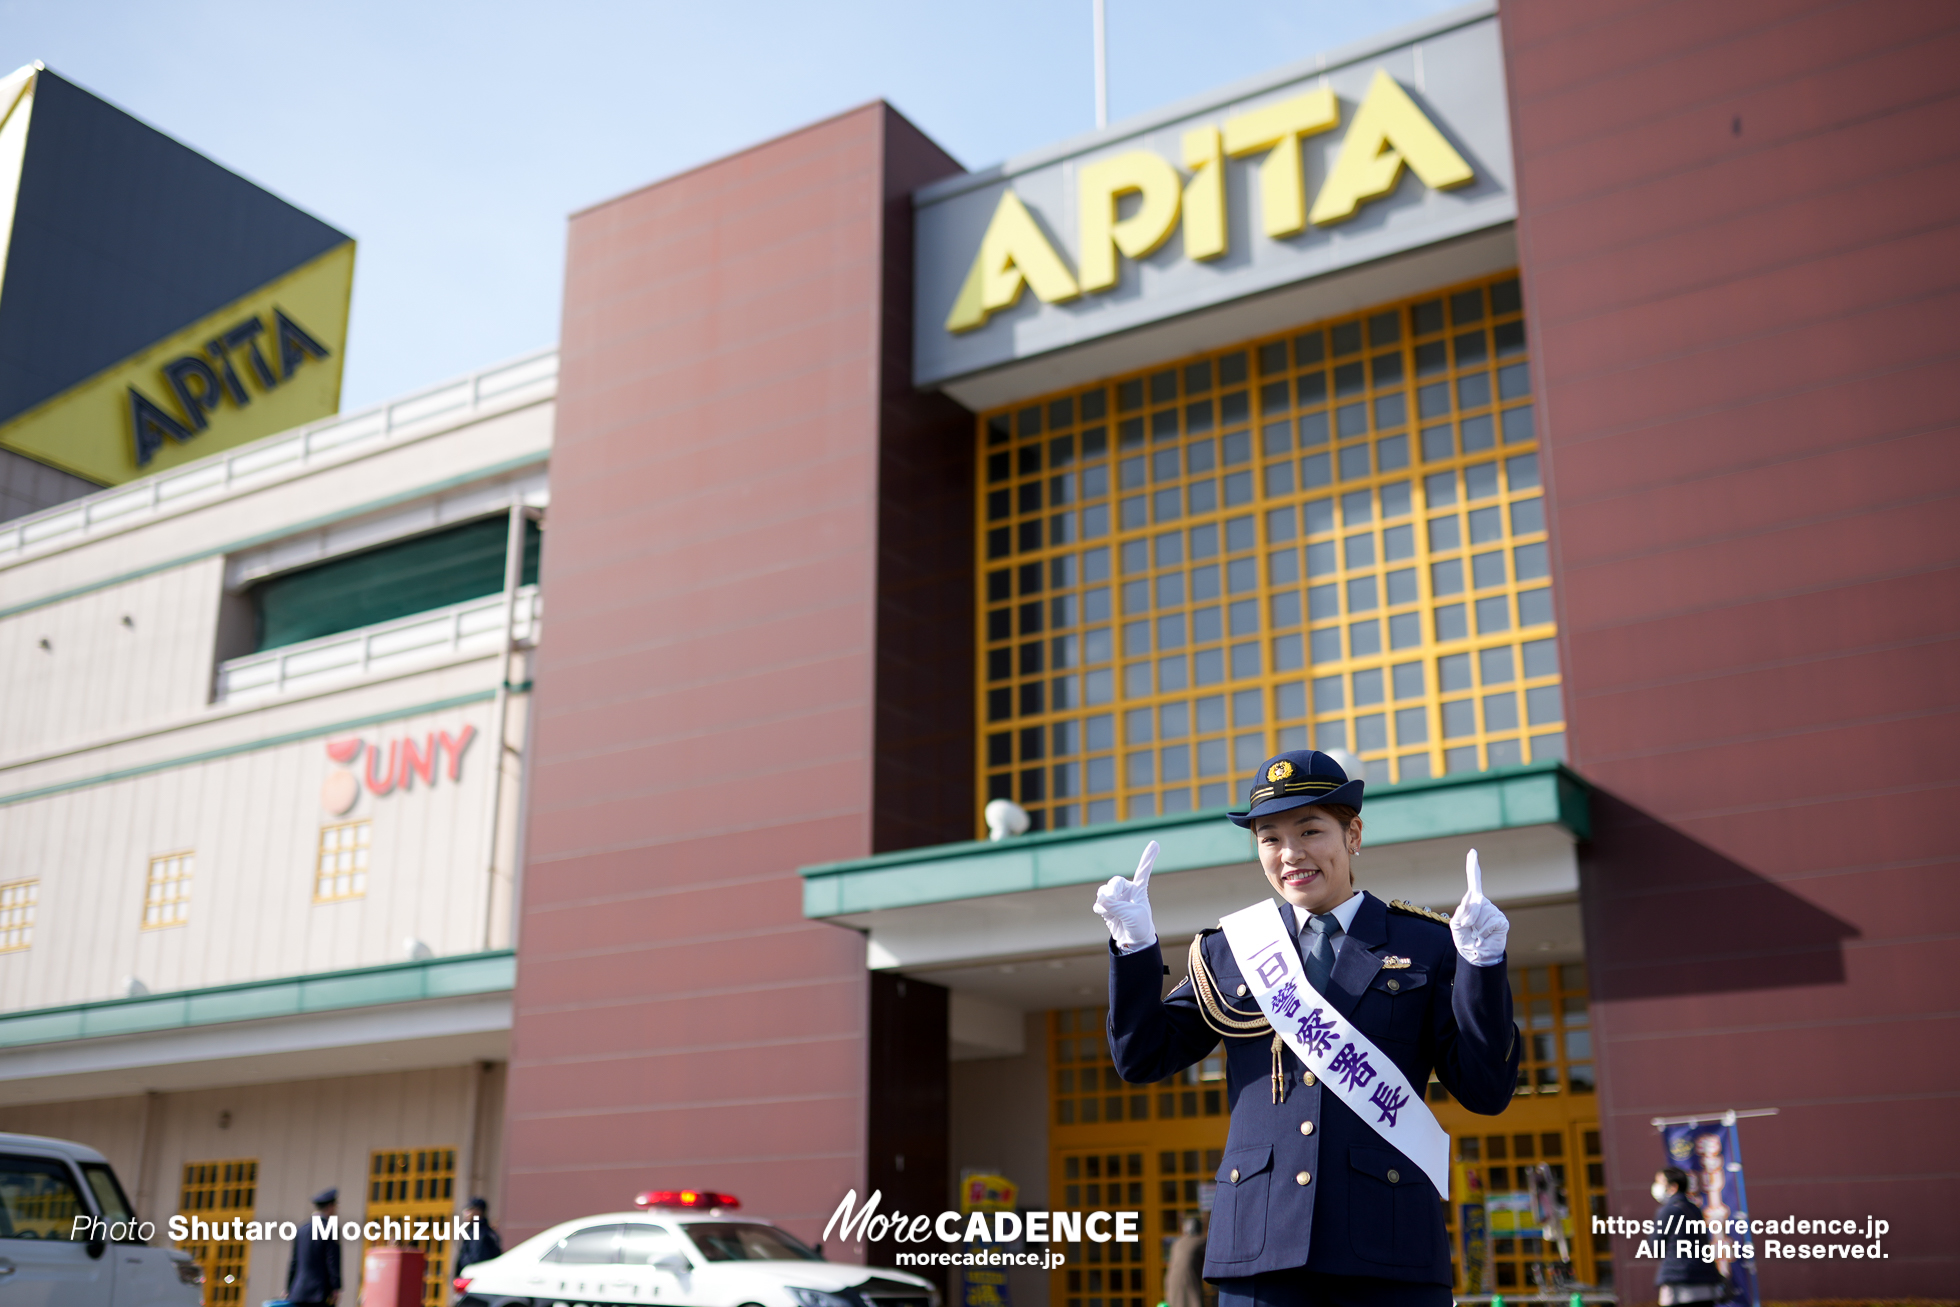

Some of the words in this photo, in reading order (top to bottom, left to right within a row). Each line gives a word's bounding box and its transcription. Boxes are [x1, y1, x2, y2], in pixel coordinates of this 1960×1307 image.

[364, 725, 477, 797] UNY
[1247, 939, 1410, 1128] 一日警察署長
